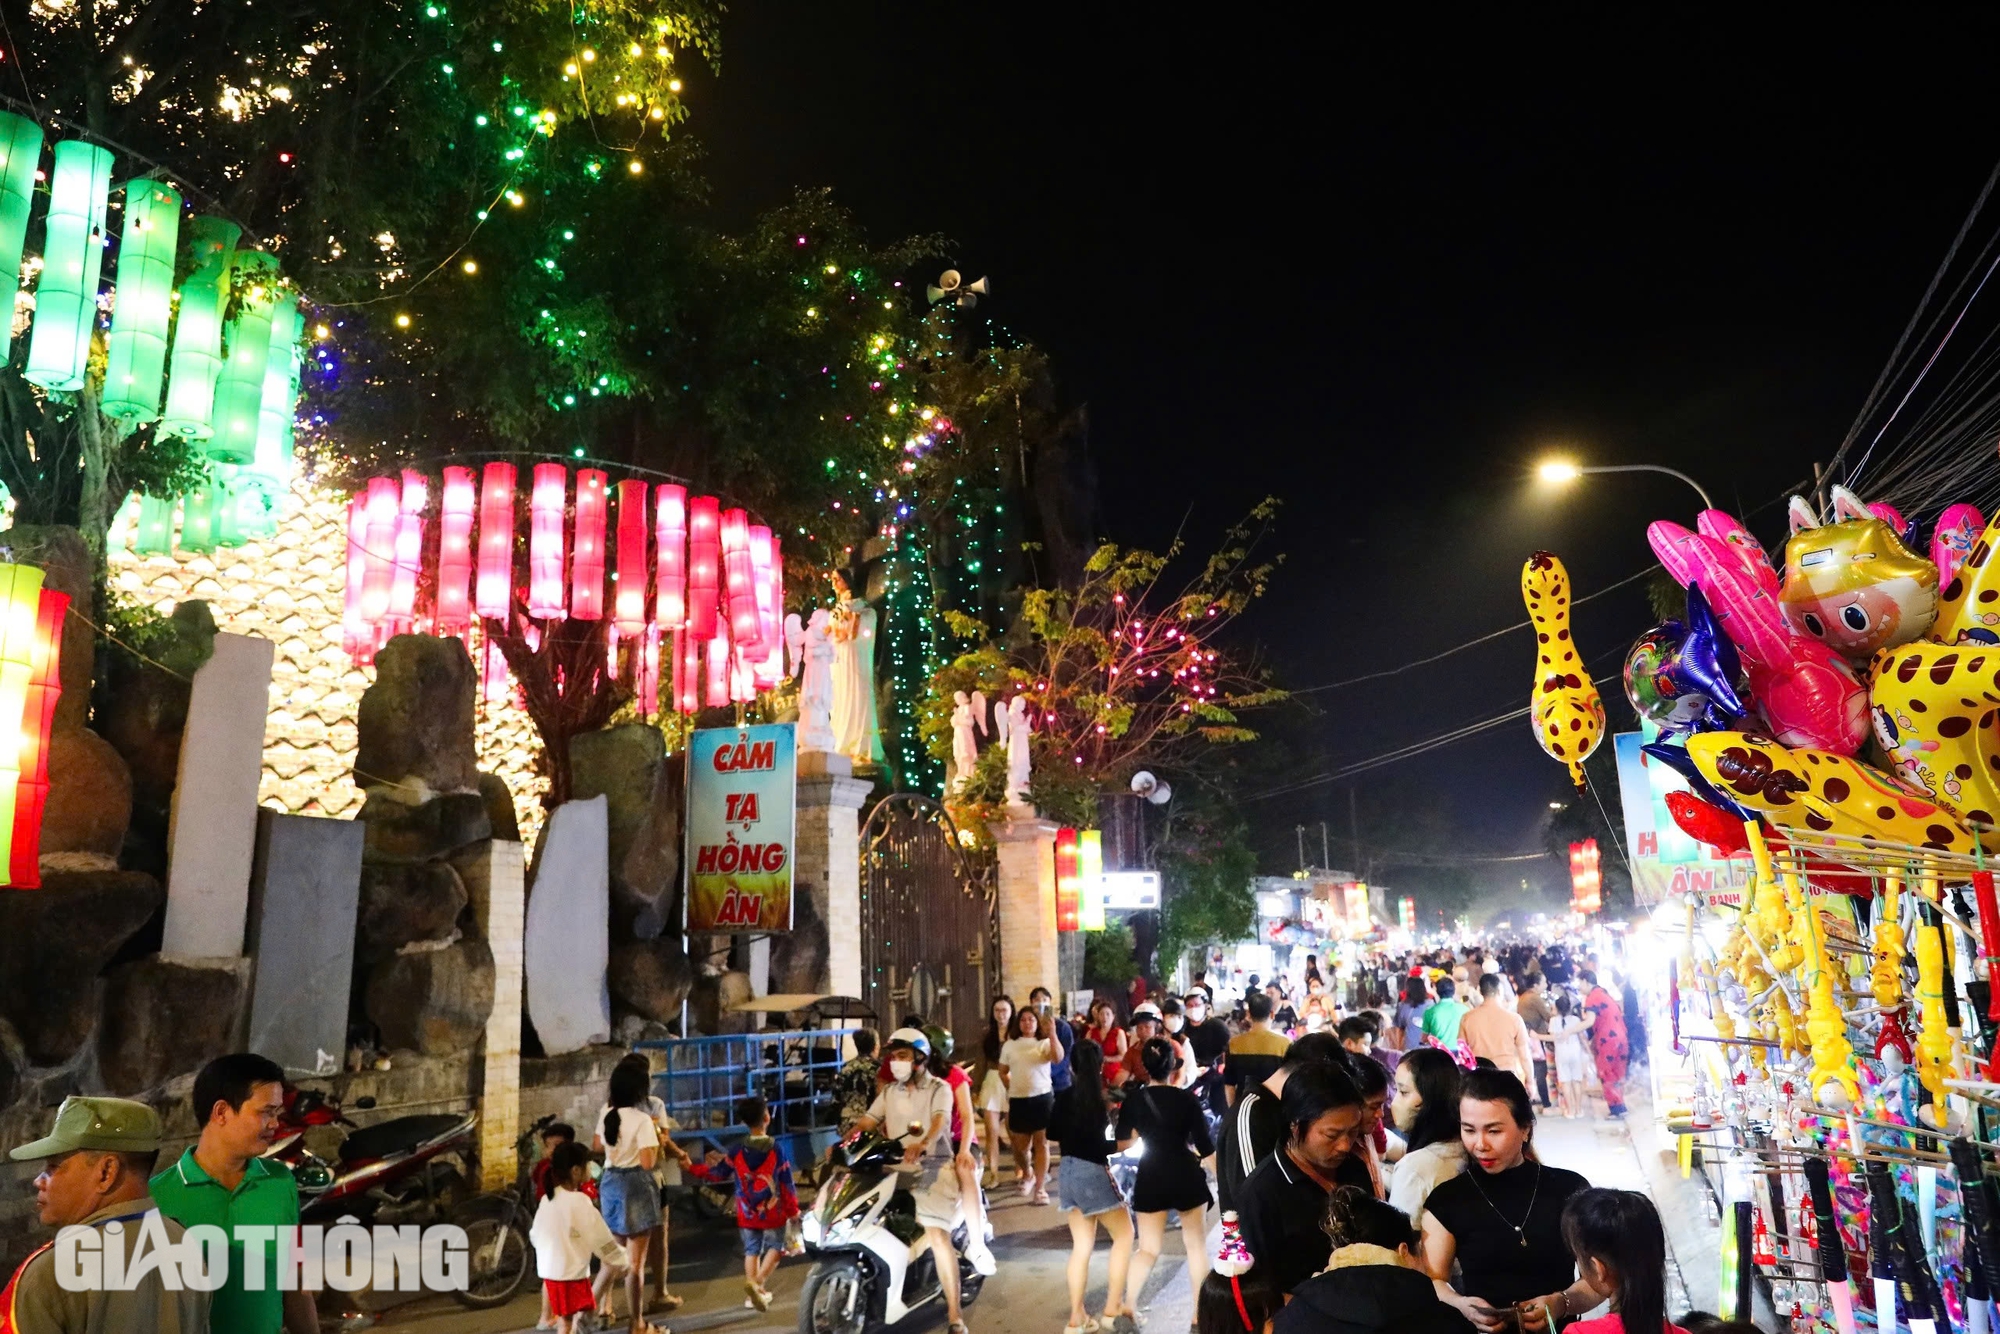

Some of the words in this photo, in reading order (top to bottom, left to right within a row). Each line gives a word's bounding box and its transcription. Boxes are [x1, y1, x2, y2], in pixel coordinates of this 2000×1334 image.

[713, 733, 775, 771] CẢM
[725, 793, 758, 830] TẠ
[696, 831, 785, 873] HỒNG
[1668, 866, 1713, 895] ÂN
[715, 888, 761, 925] ÂN
